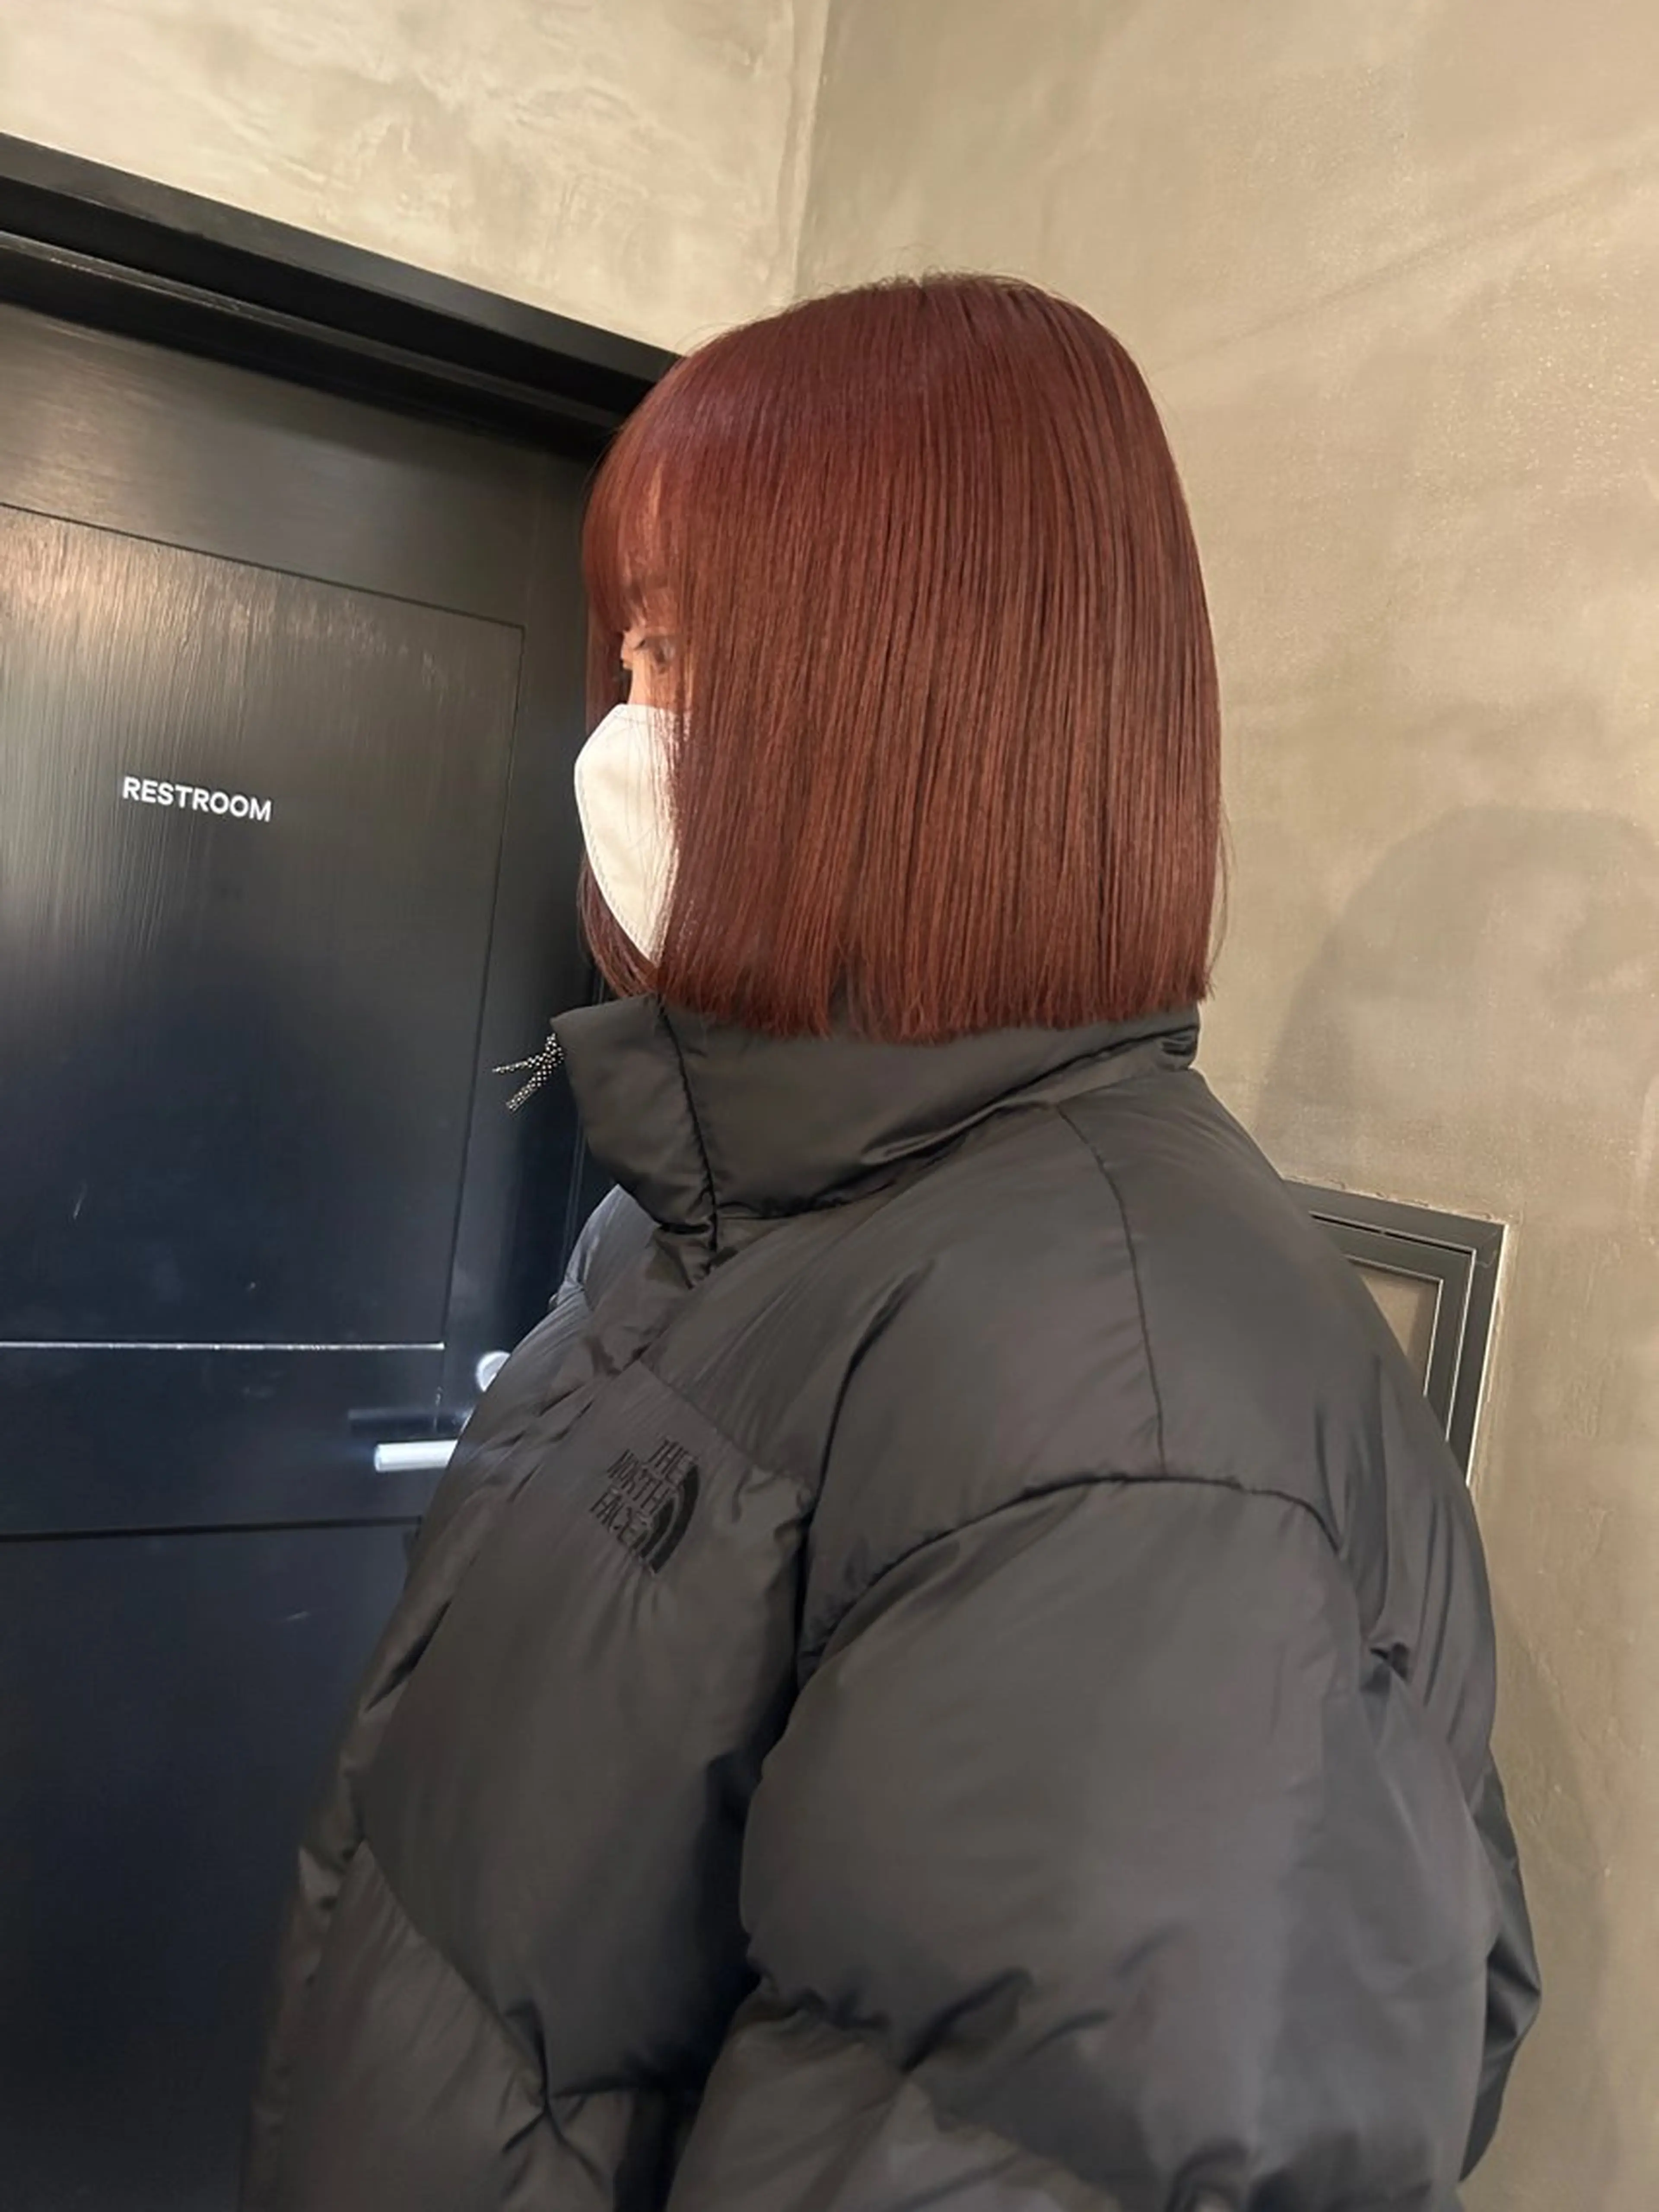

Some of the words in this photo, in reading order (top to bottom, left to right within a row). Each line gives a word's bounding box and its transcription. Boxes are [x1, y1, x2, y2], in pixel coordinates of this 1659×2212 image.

[122, 776, 272, 823] RESTROOM
[607, 1448, 672, 1515] NORTH
[648, 1439, 696, 1484] THE
[589, 1488, 647, 1544] FACE
